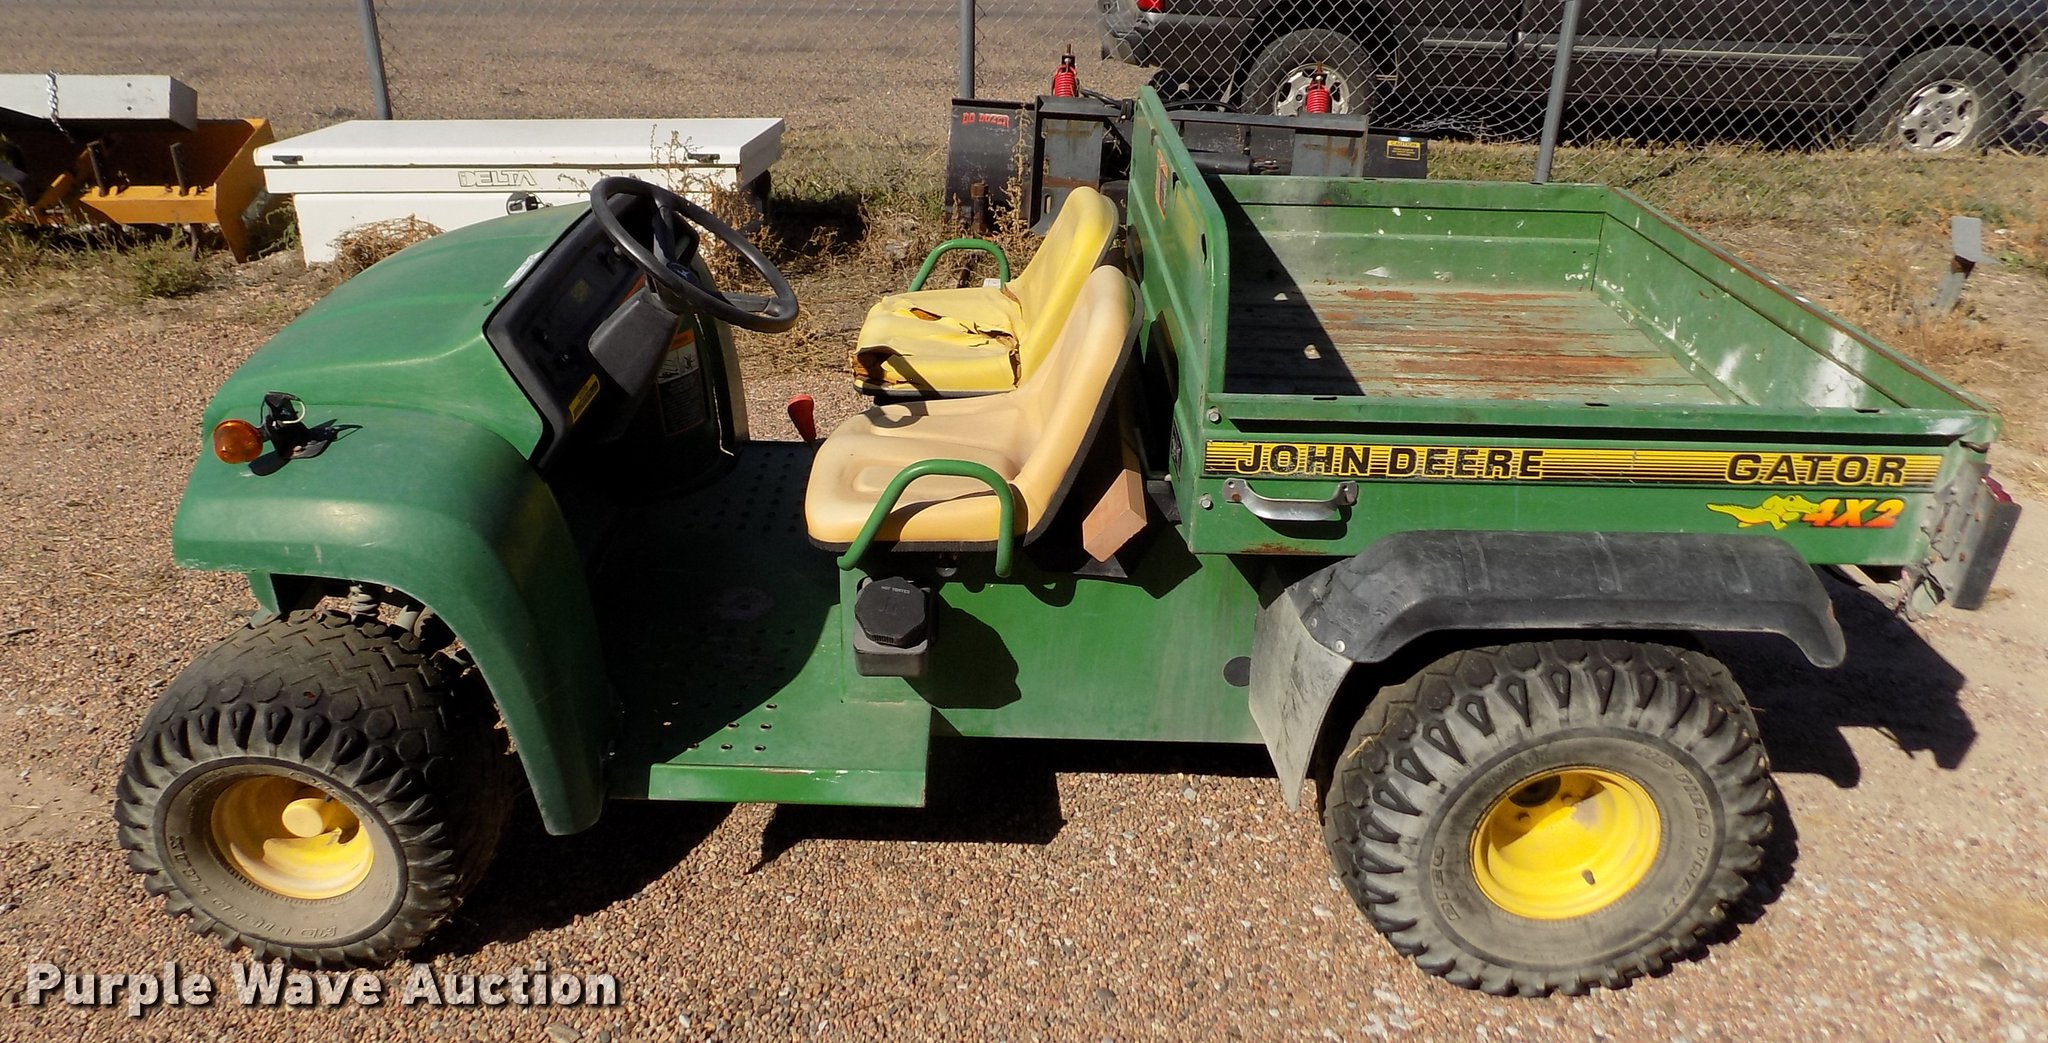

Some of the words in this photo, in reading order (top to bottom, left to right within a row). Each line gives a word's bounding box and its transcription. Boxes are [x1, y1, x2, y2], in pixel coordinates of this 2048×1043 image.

[458, 170, 537, 187] DELTA
[1237, 444, 1371, 476] JOHN
[1388, 447, 1544, 479] DEERE
[1727, 454, 1906, 485] GATOR
[1802, 497, 1905, 528] 4X2
